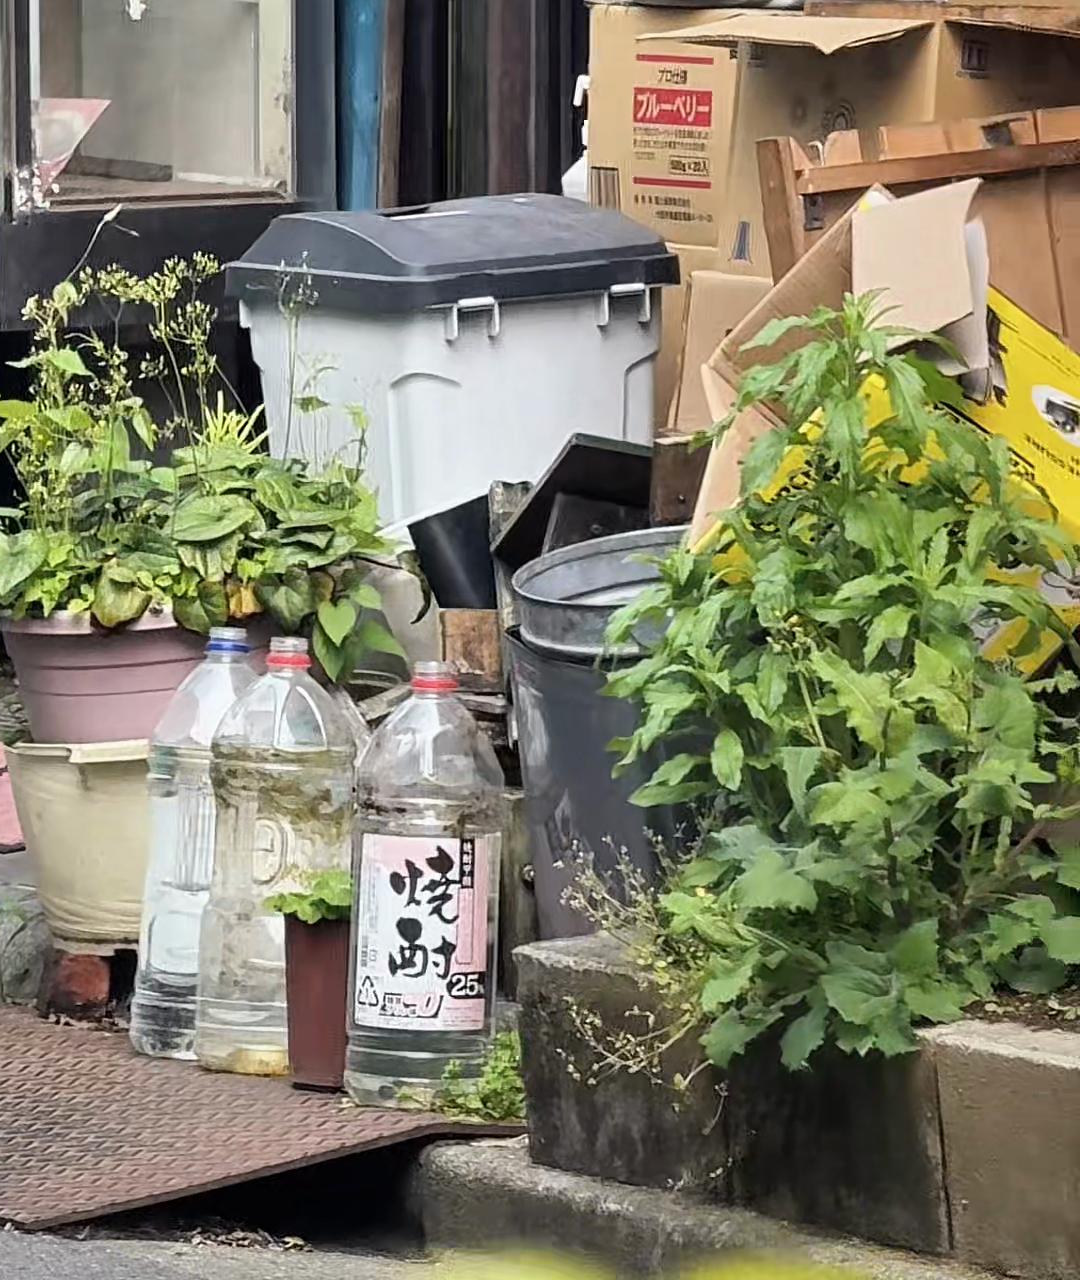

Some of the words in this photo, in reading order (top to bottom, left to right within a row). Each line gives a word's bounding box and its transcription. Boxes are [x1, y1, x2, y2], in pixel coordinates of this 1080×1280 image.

[636, 91, 710, 123] ブルーベリー
[388, 845, 462, 981] 焼酎
